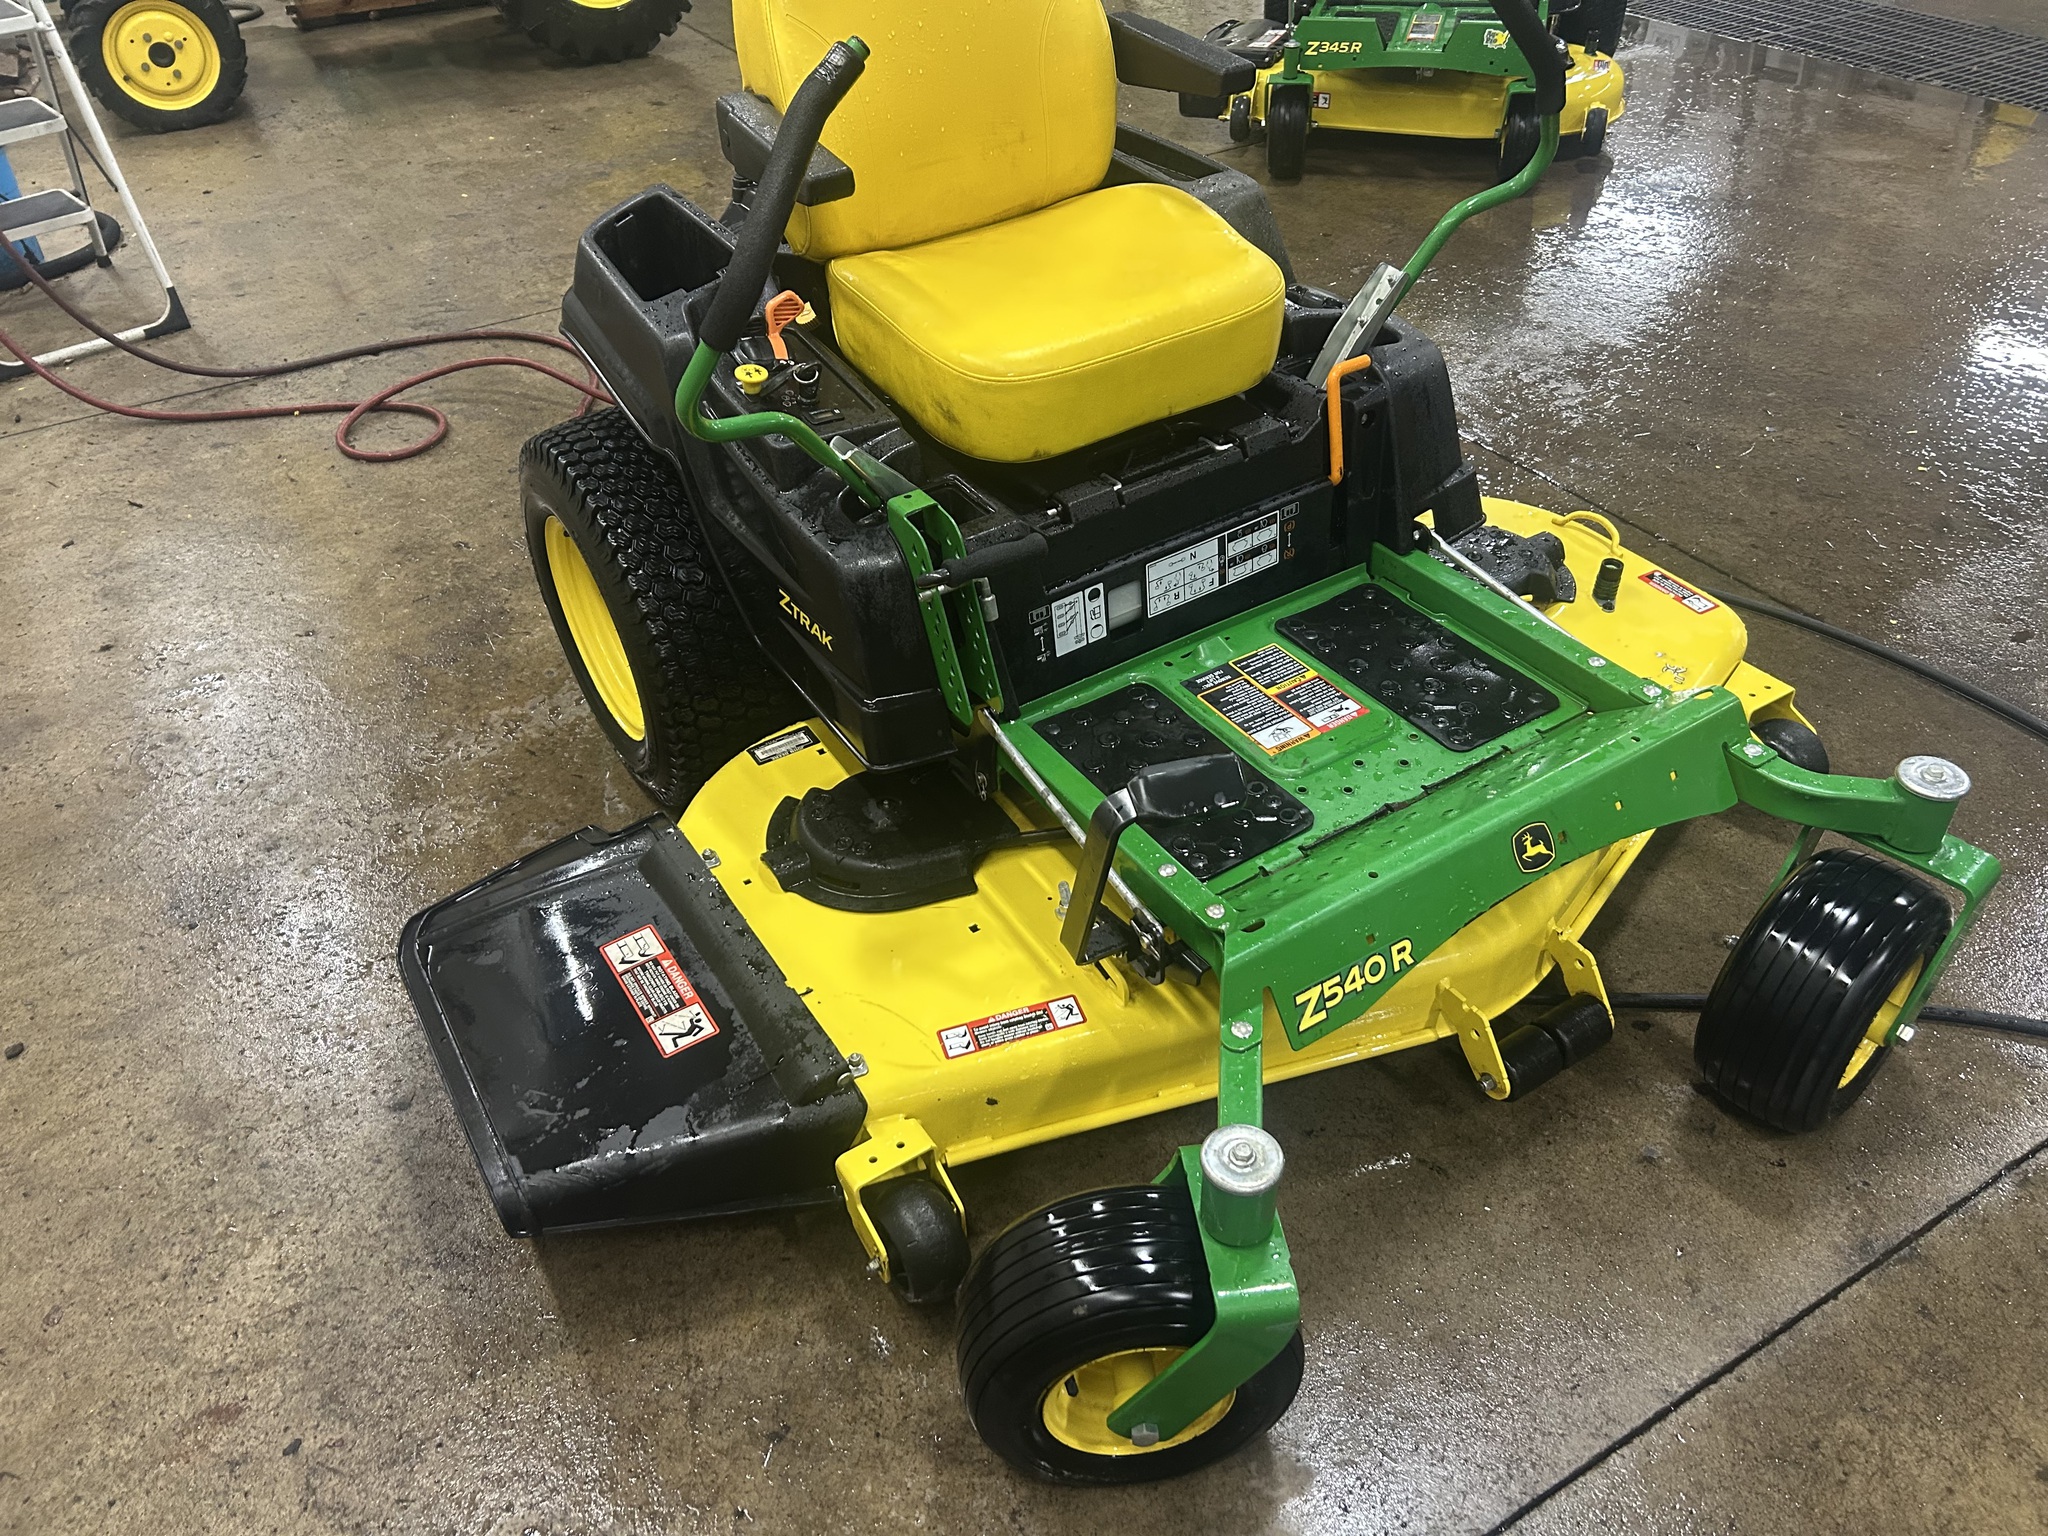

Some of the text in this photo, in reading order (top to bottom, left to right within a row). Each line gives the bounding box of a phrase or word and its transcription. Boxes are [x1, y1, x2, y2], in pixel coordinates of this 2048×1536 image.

[1305, 41, 1362, 56] Z345R
[1190, 551, 1196, 560] N
[1208, 578, 1214, 586] F
[1174, 591, 1179, 600] R
[778, 588, 833, 652] ZTRAK
[1275, 677, 1301, 691] CAUTION
[1326, 715, 1352, 729] DANGER
[1276, 737, 1306, 750] WARNING
[667, 965, 694, 999] DANGER
[995, 1007, 1029, 1021] DANGER
